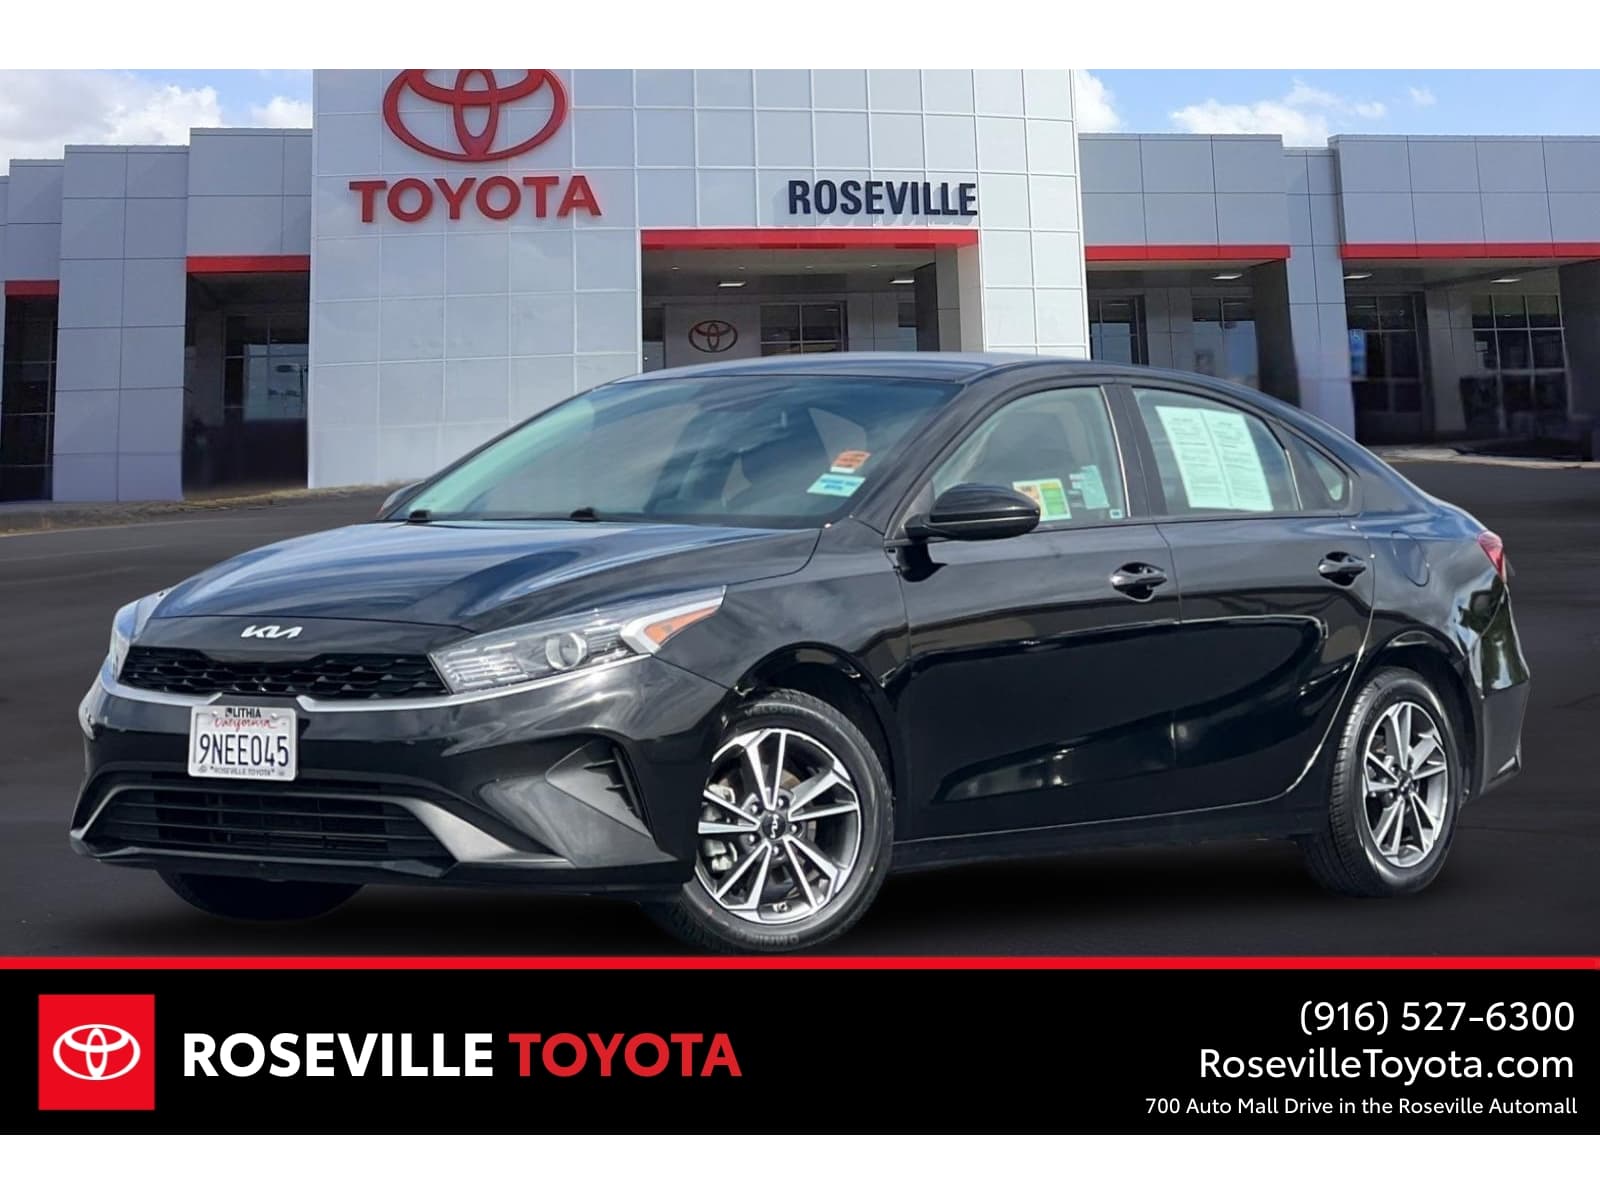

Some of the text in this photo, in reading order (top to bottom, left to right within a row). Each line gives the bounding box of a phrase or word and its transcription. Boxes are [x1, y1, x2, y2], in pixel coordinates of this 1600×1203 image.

[349, 175, 602, 223] TOYOTA
[788, 180, 979, 217] ROSEVILLE
[232, 707, 262, 719] LITHIA
[199, 733, 289, 767] 9NEE045
